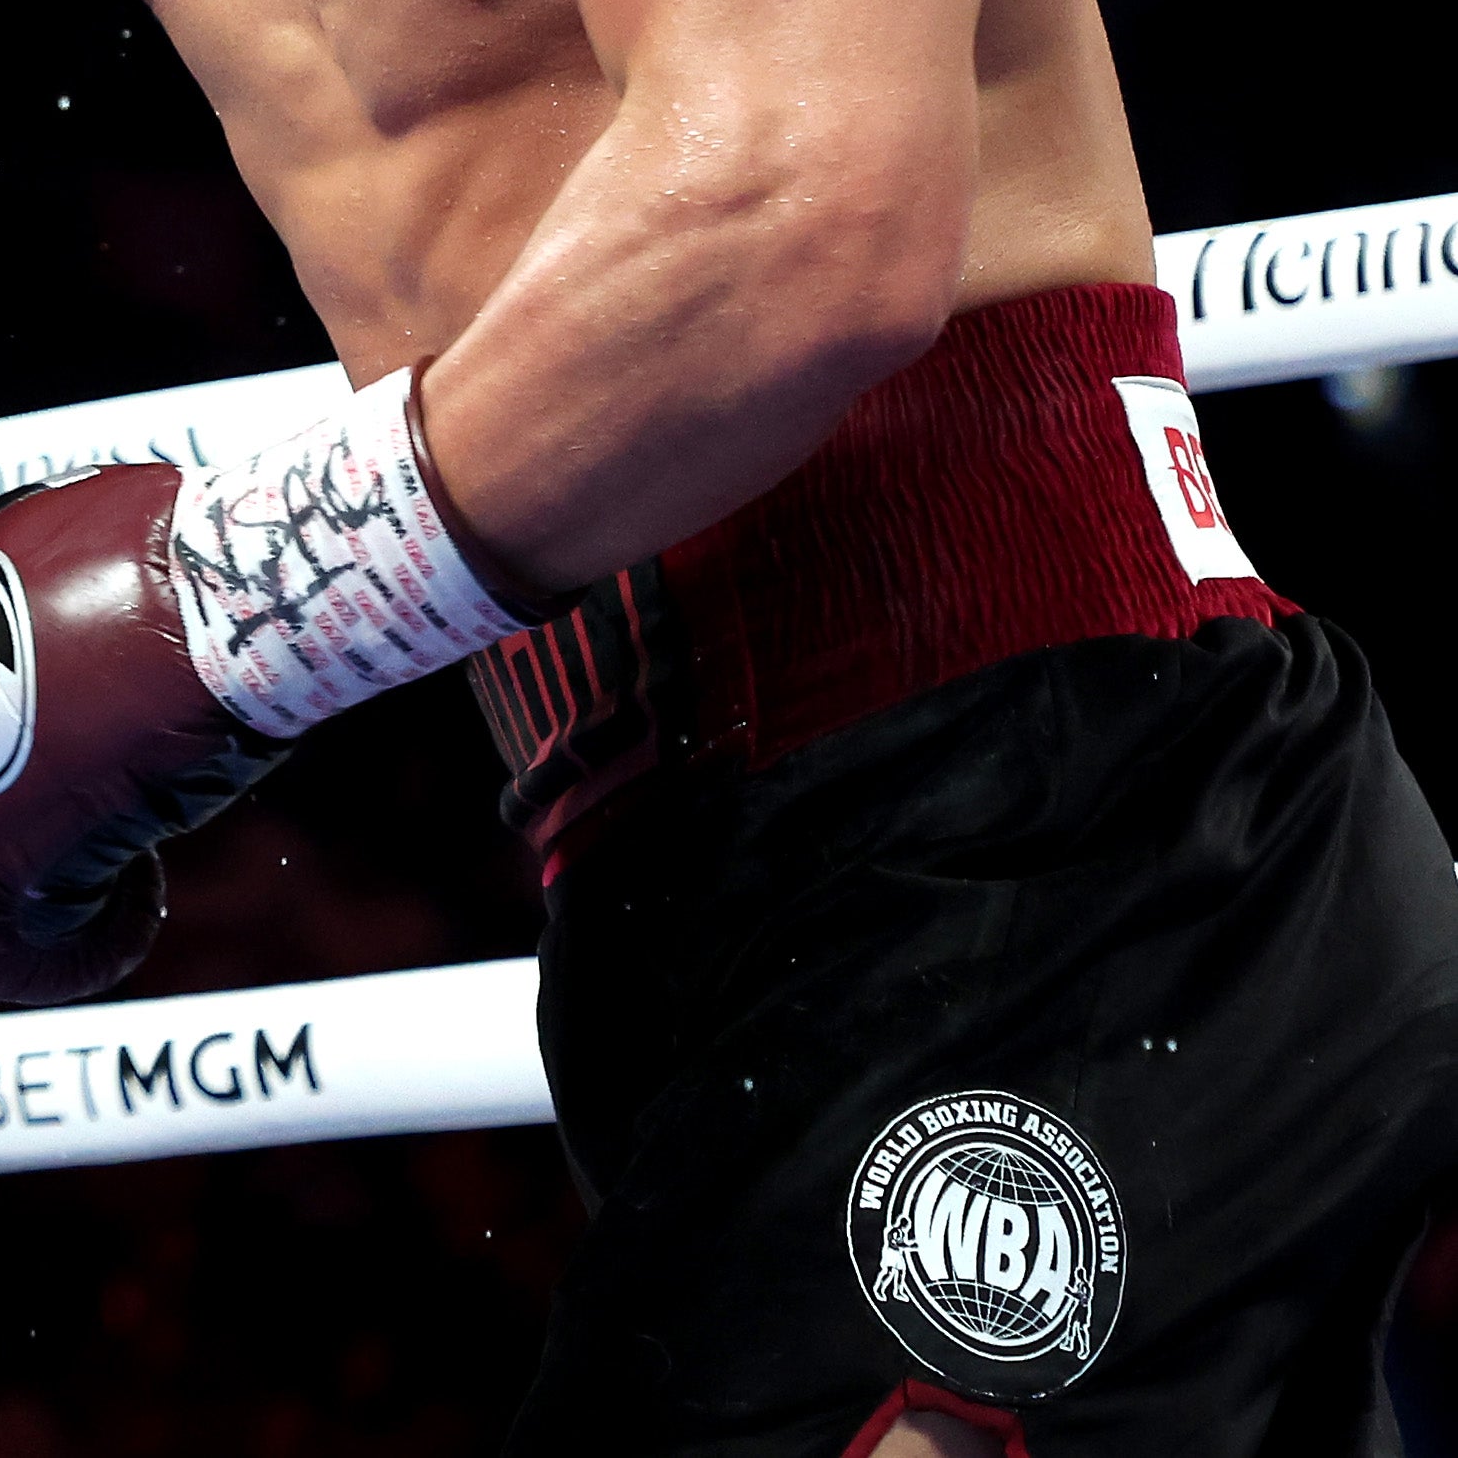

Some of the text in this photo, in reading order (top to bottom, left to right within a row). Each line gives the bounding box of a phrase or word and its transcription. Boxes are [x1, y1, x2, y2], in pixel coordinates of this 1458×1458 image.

[859, 1099, 1121, 1275] WORLD BOXING ASSOCIATION
[913, 1166, 1073, 1321] WBA
